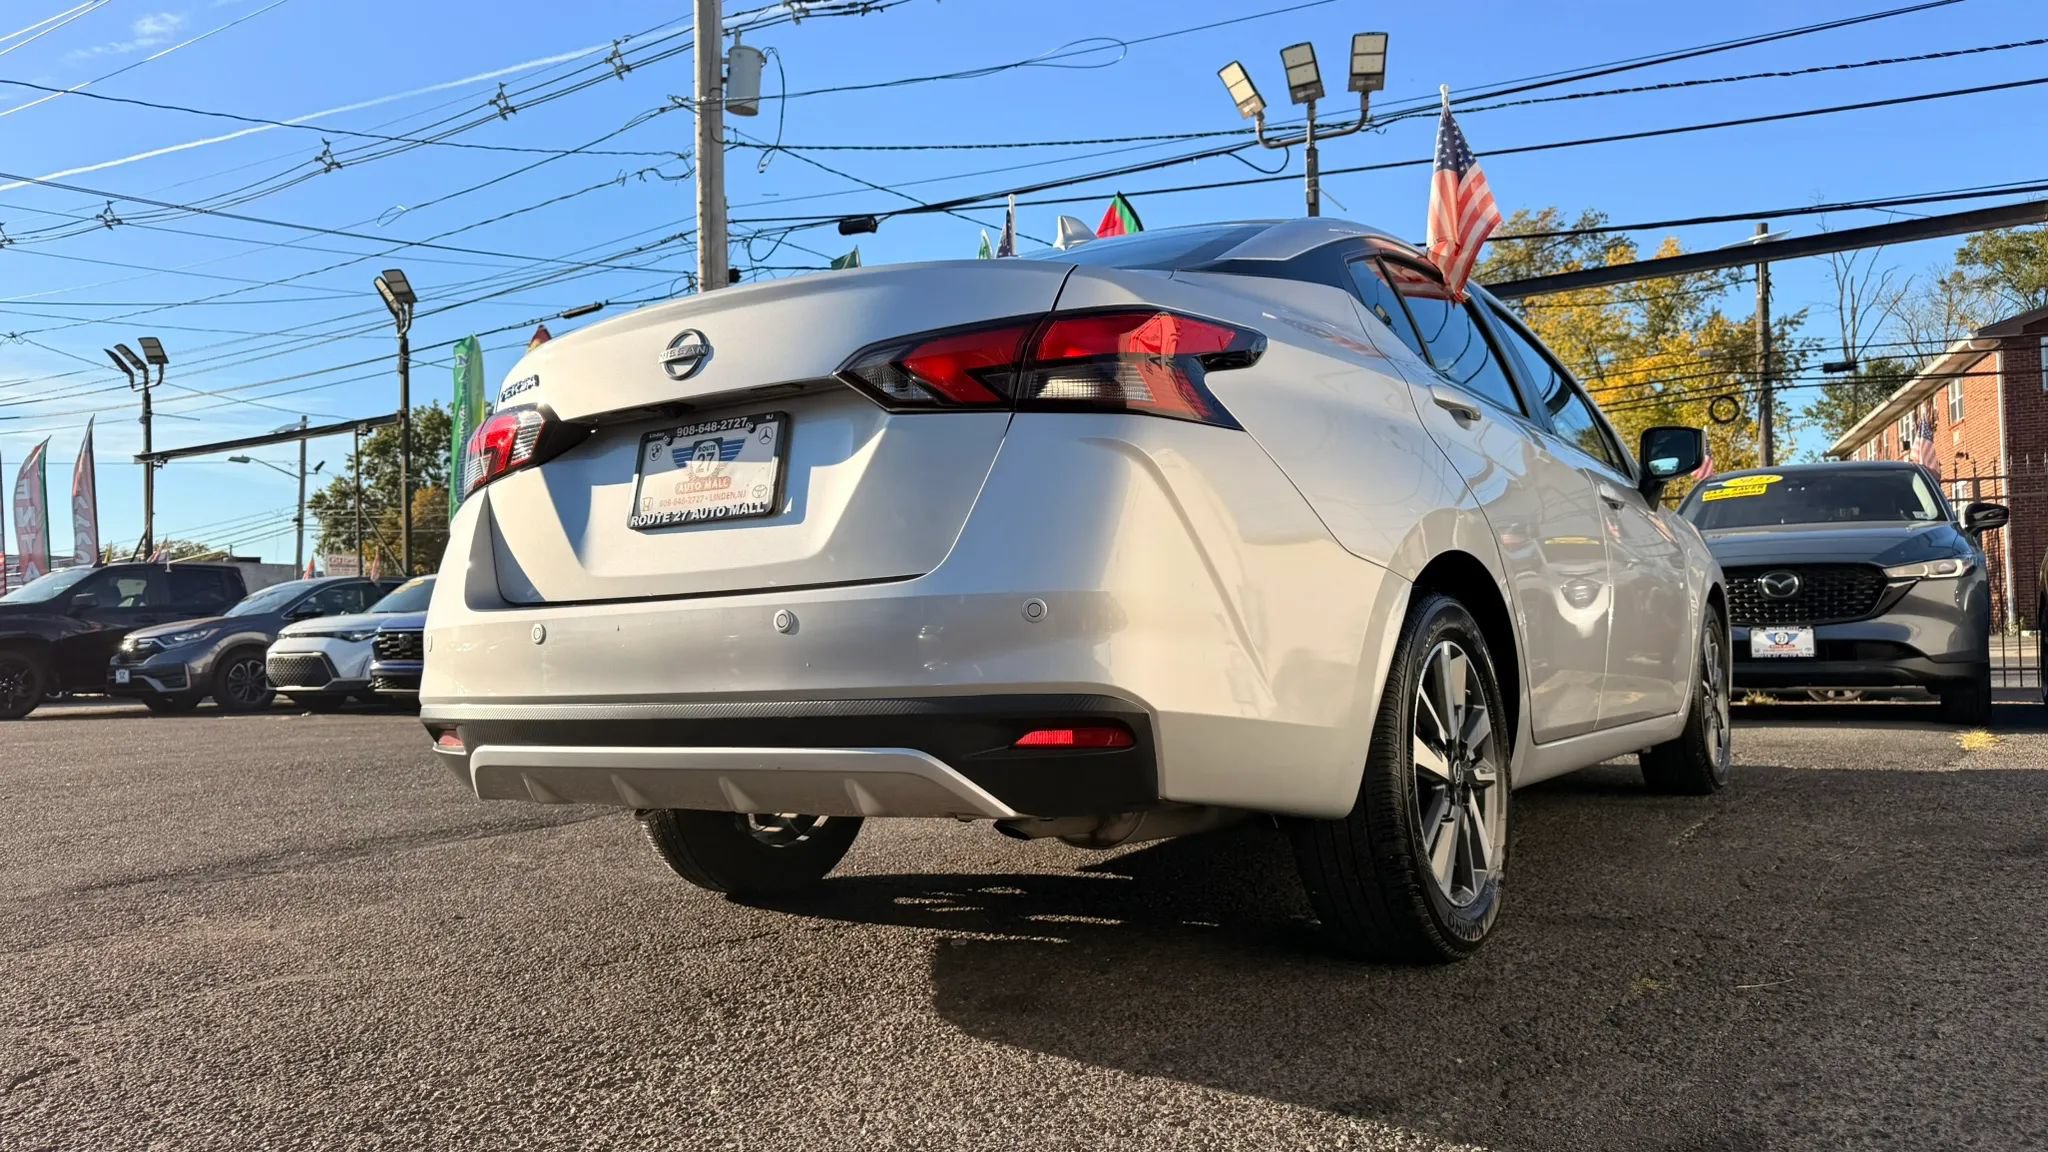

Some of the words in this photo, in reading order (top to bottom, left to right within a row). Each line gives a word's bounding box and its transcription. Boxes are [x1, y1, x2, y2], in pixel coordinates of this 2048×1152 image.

[660, 345, 707, 359] NISSAN
[698, 444, 716, 452] ROUTE
[695, 452, 715, 474] 27
[678, 481, 702, 493] AUTO
[704, 477, 730, 489] MALL
[630, 512, 671, 527] ROUTE
[672, 510, 688, 522] 27
[691, 506, 727, 520] AUTO
[728, 501, 764, 515] MALL
